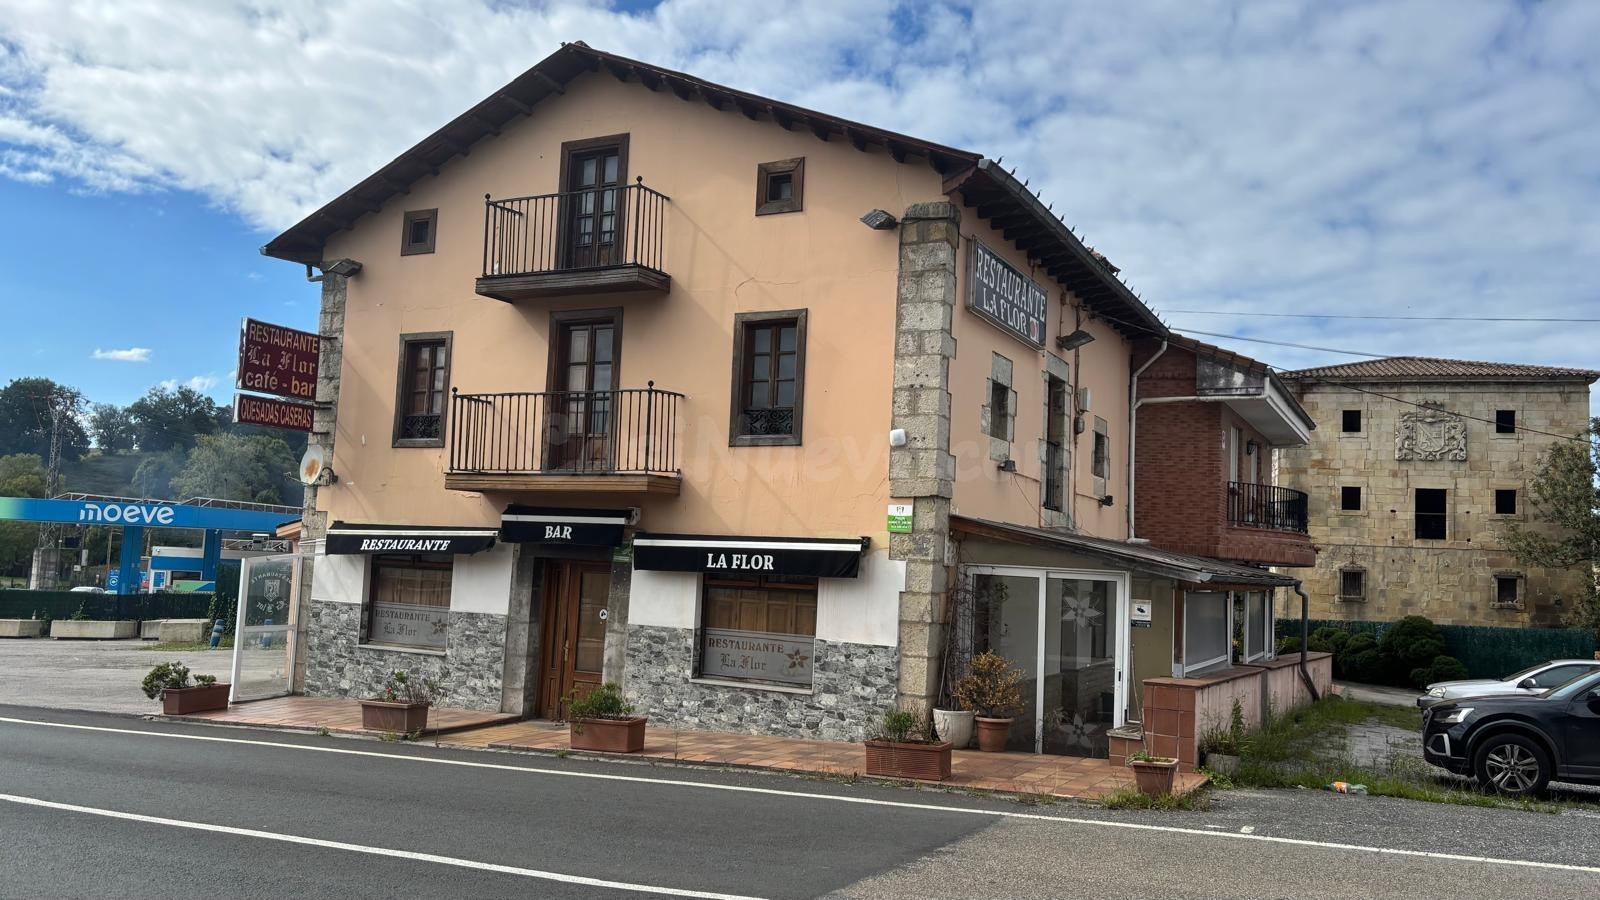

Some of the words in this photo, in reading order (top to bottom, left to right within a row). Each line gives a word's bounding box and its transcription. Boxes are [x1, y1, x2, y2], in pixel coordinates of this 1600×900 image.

[976, 248, 1046, 322] RESTAURANTE
[983, 287, 998, 317] LA
[1000, 298, 1027, 334] FLOR
[248, 323, 319, 353] RESTAURANTE
[247, 344, 270, 367] La
[277, 351, 316, 375] Flor
[245, 371, 278, 390] café
[291, 376, 315, 397] bar
[240, 399, 279, 423] QUESADAS
[280, 406, 312, 428] CASERAS
[79, 503, 175, 525] moeve
[360, 539, 450, 551] RESTAURANTE
[544, 526, 572, 540] BAR
[706, 553, 727, 569] LA
[731, 554, 774, 570] FLOR
[375, 609, 431, 622] RESTAURANTE
[708, 637, 784, 654] RESTAURANTE
